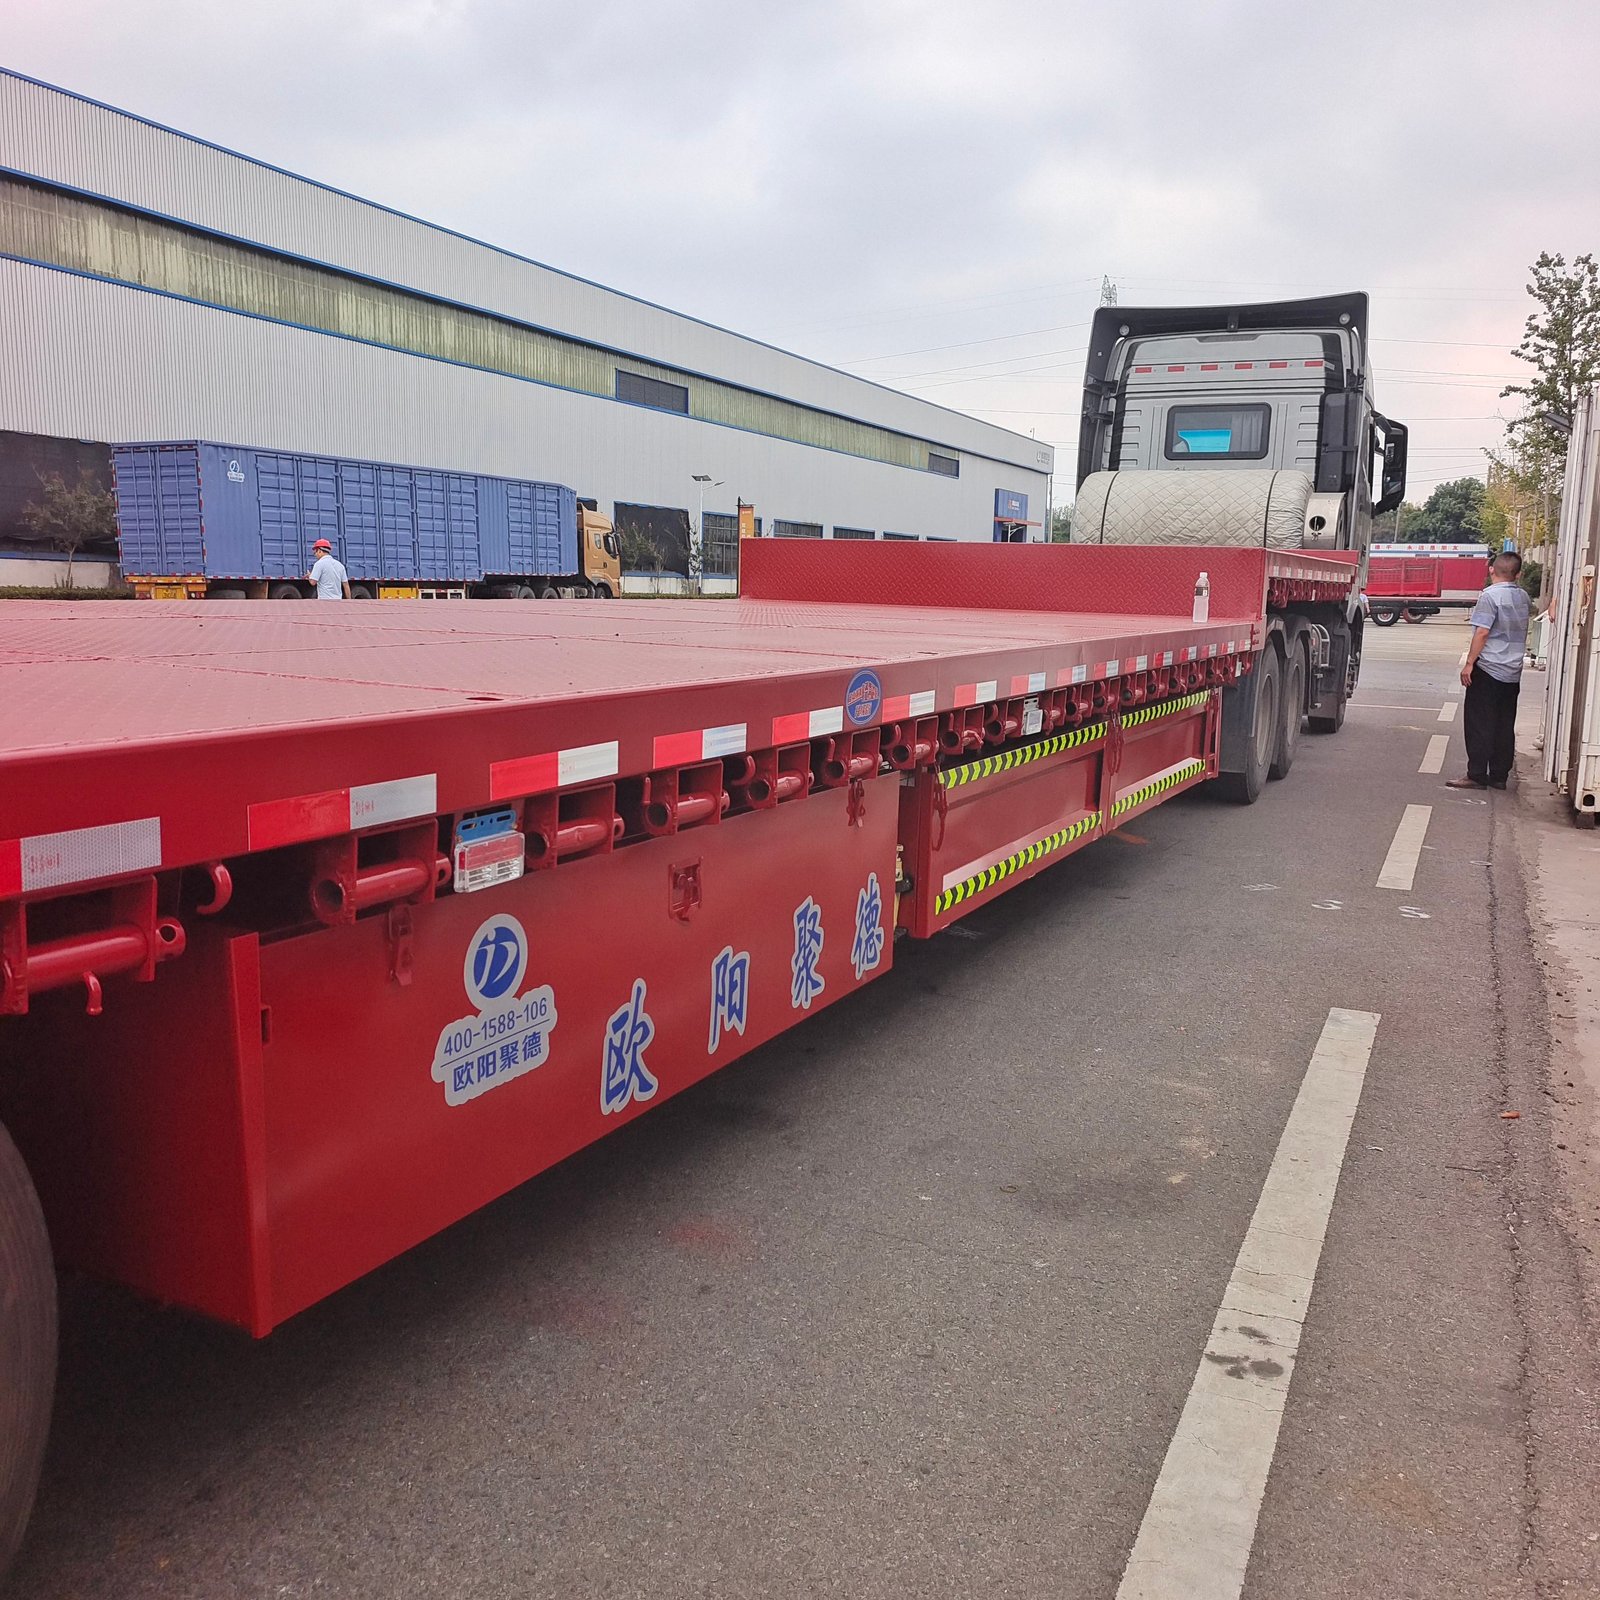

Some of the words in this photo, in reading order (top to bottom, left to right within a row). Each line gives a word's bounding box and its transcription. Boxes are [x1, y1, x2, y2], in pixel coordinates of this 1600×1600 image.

[443, 997, 548, 1056] 400-1588-106
[453, 1031, 542, 1092] 欧阳聚德
